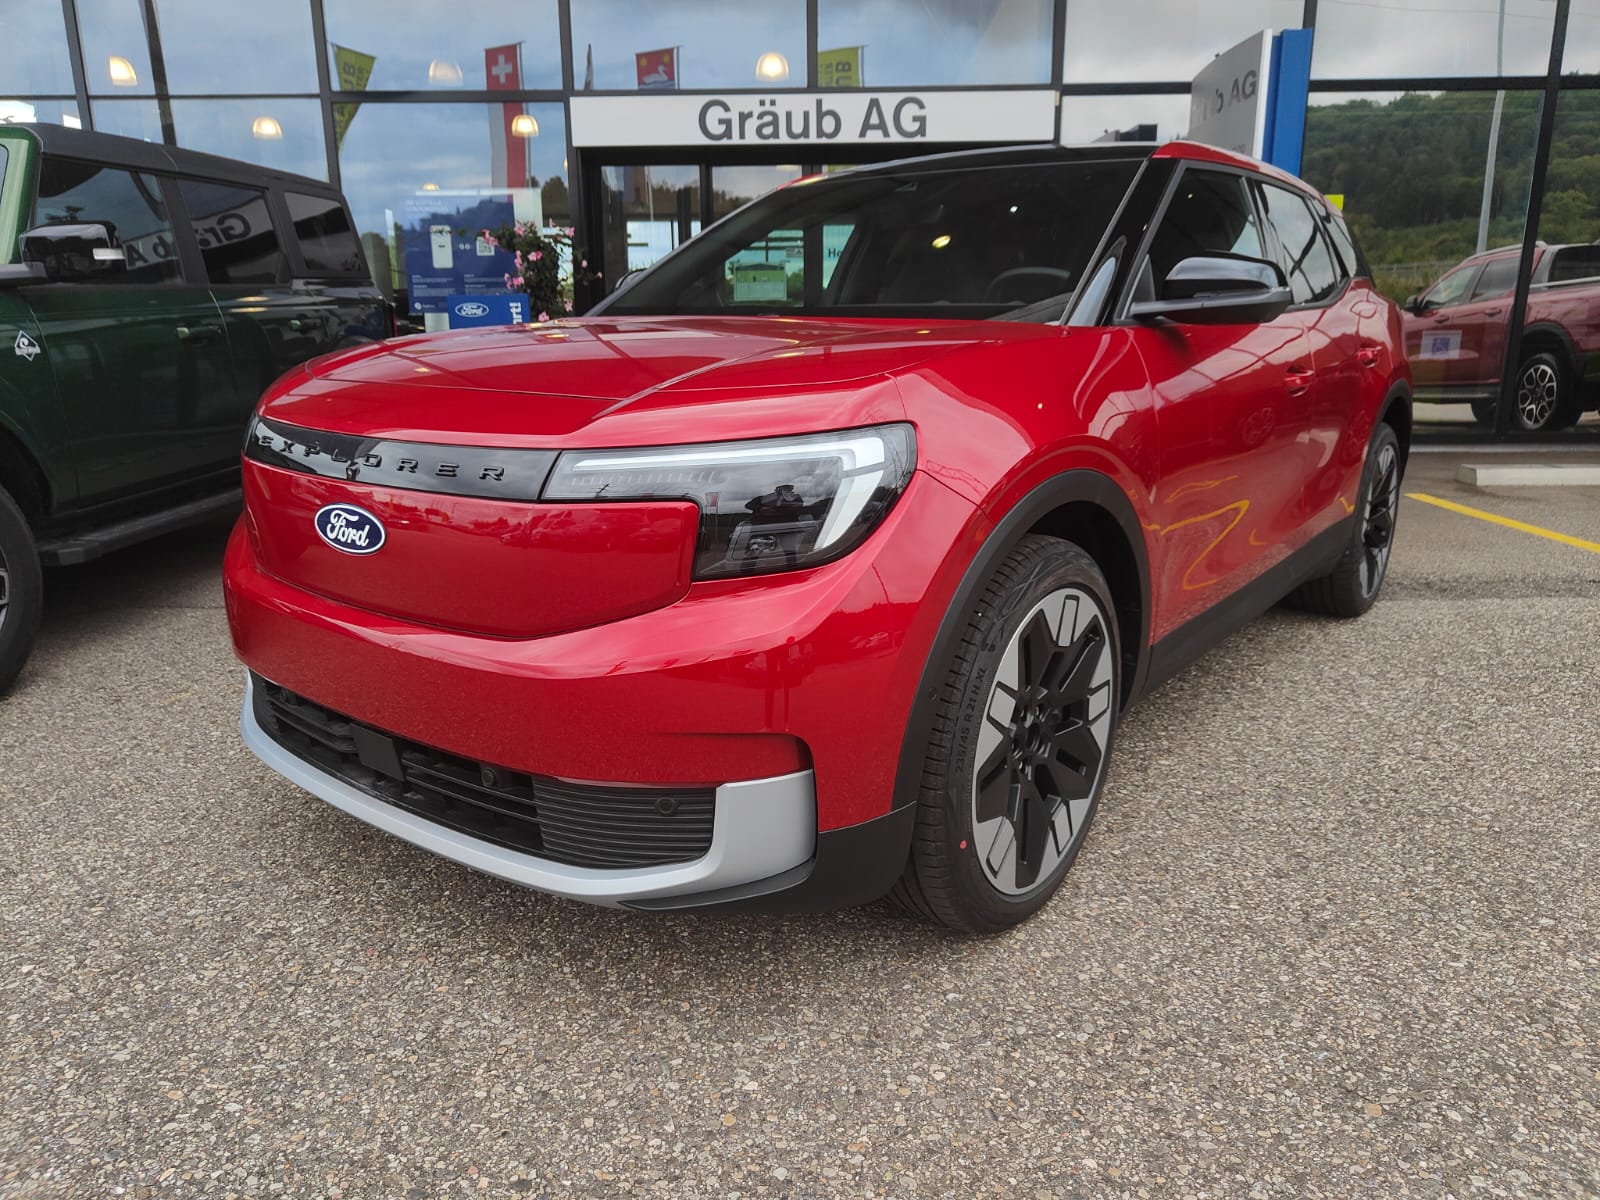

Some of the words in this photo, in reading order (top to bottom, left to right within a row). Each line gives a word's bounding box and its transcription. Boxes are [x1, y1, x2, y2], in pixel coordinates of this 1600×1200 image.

[1228, 69, 1257, 108] AG
[698, 98, 842, 141] Gräub
[858, 96, 927, 138] AG
[460, 303, 484, 315] Ford
[259, 435, 505, 481] EXPLORER
[325, 508, 371, 548] Ford
[955, 727, 970, 773] 235/45
